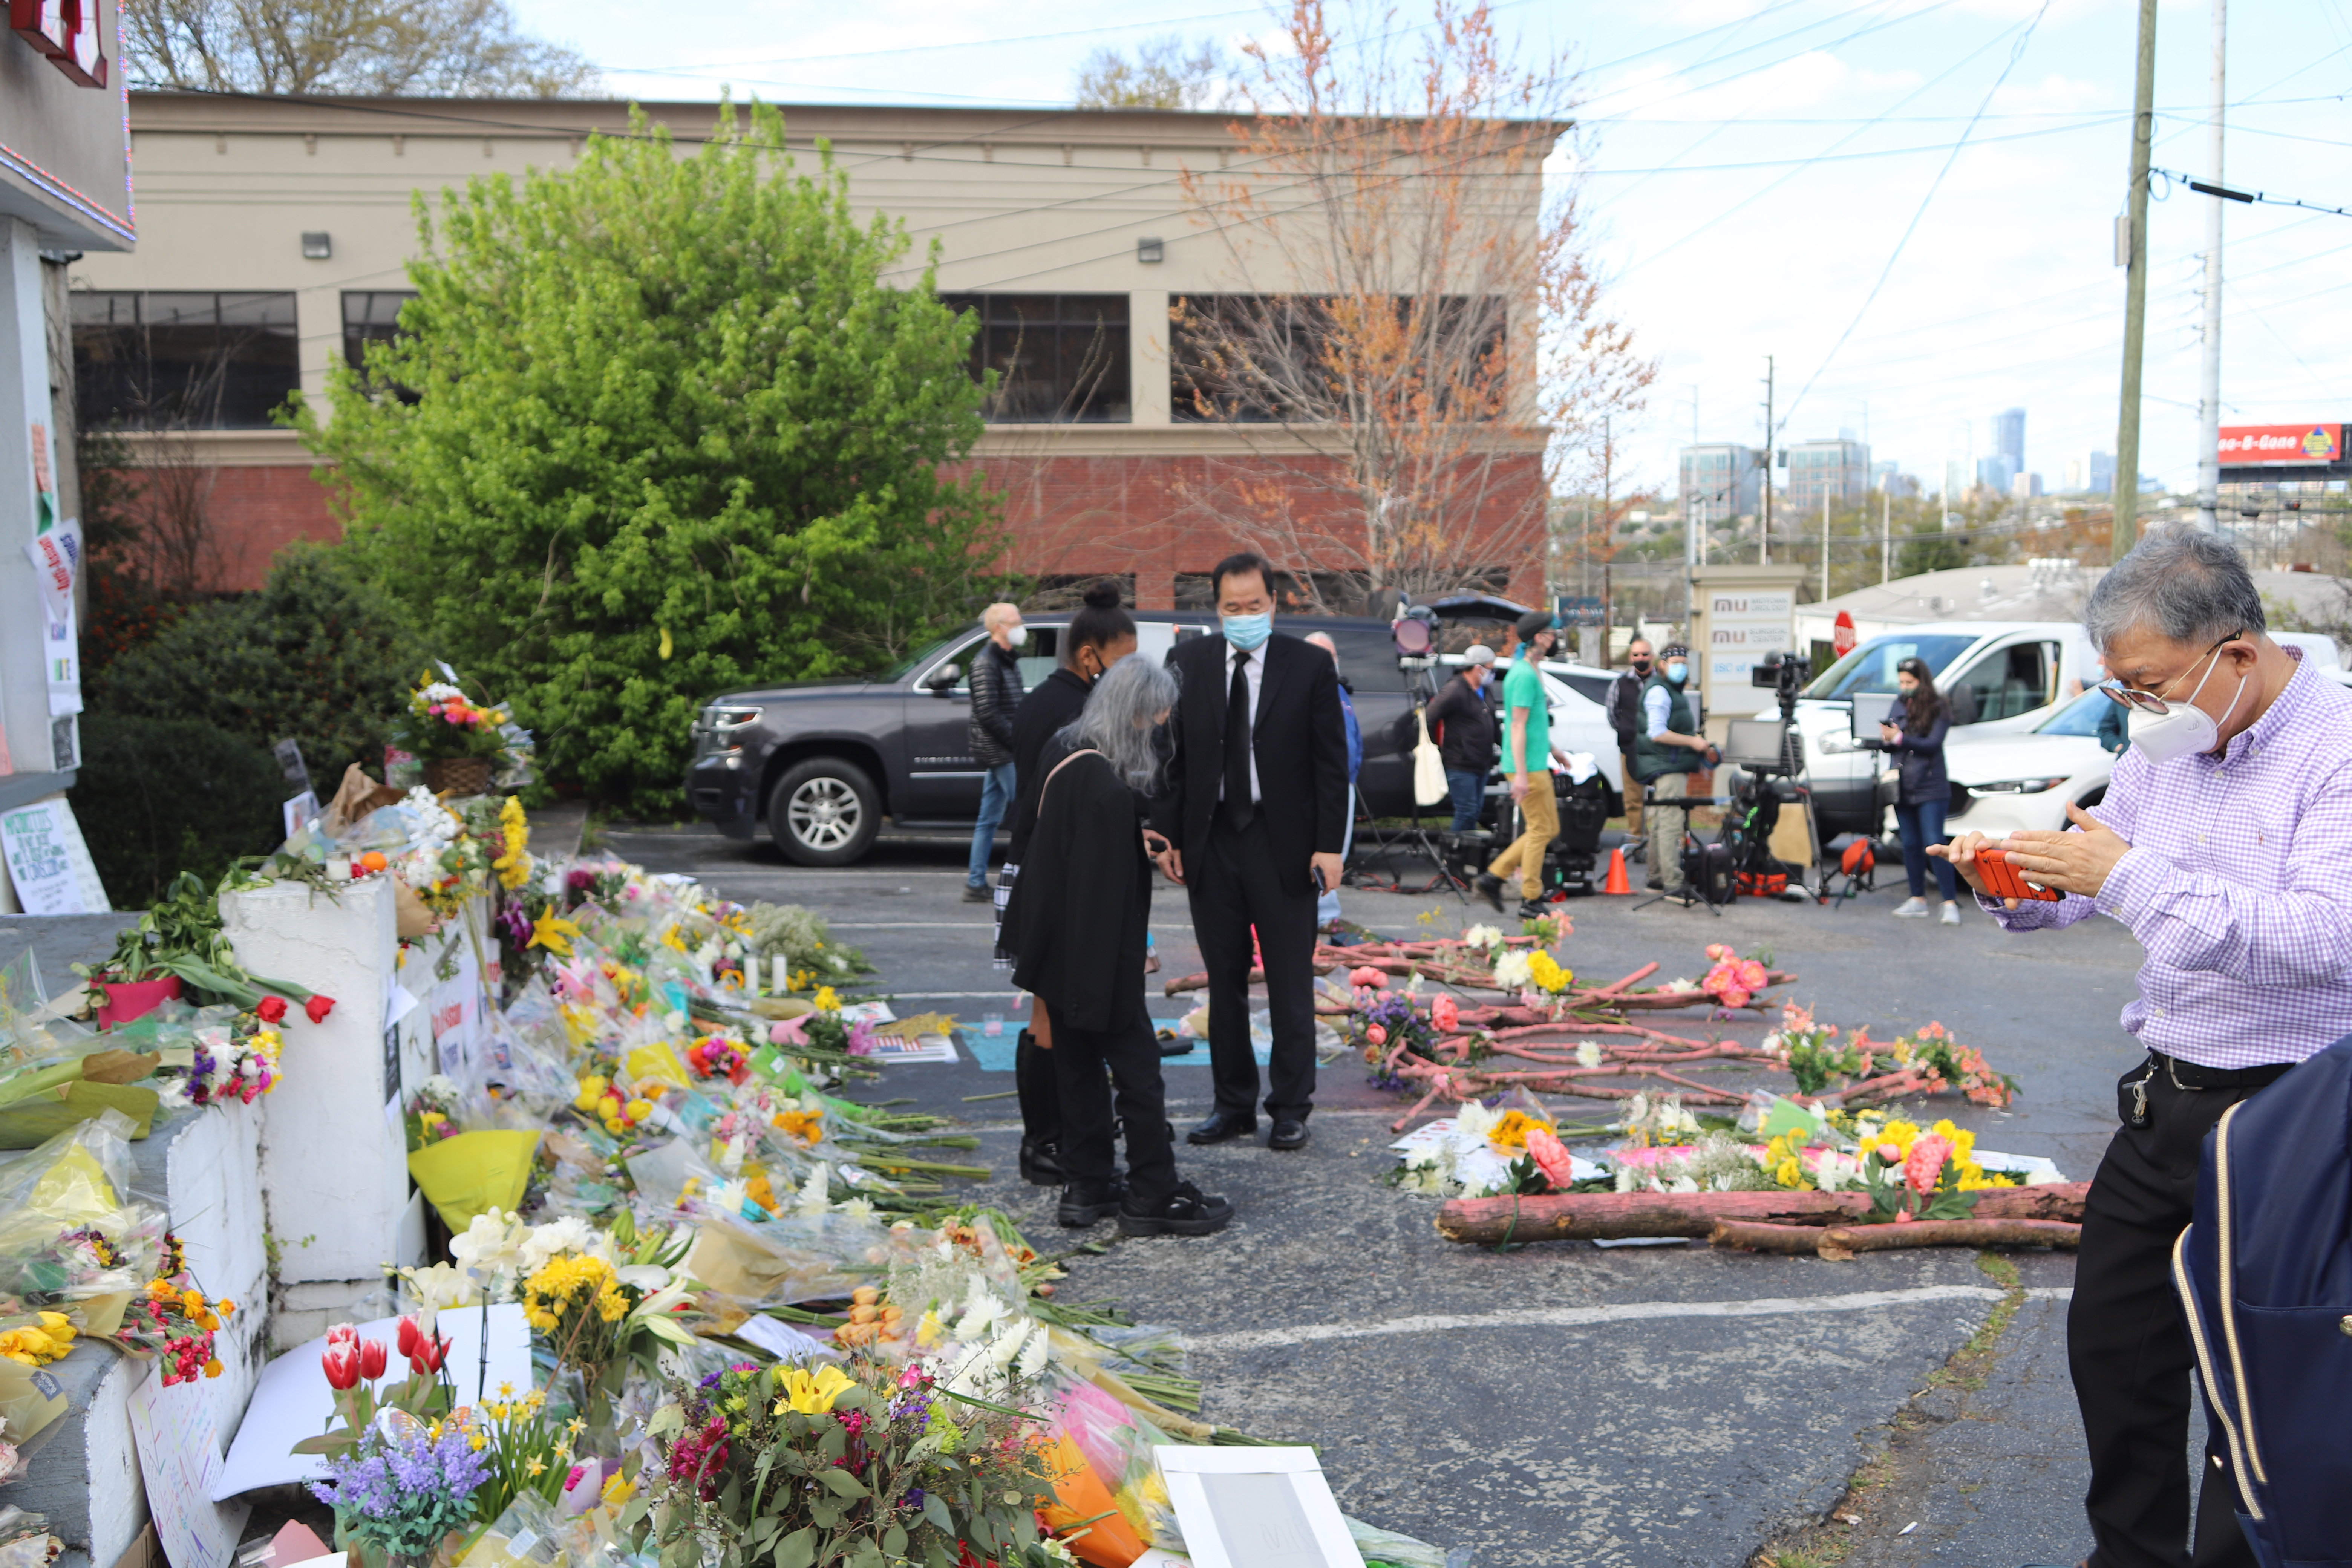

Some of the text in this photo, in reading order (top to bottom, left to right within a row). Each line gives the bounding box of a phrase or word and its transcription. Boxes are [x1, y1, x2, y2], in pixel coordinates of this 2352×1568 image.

[1835, 625, 1854, 648] STOP
[1714, 663, 1733, 672] ISC
[1736, 662, 1747, 672] of
